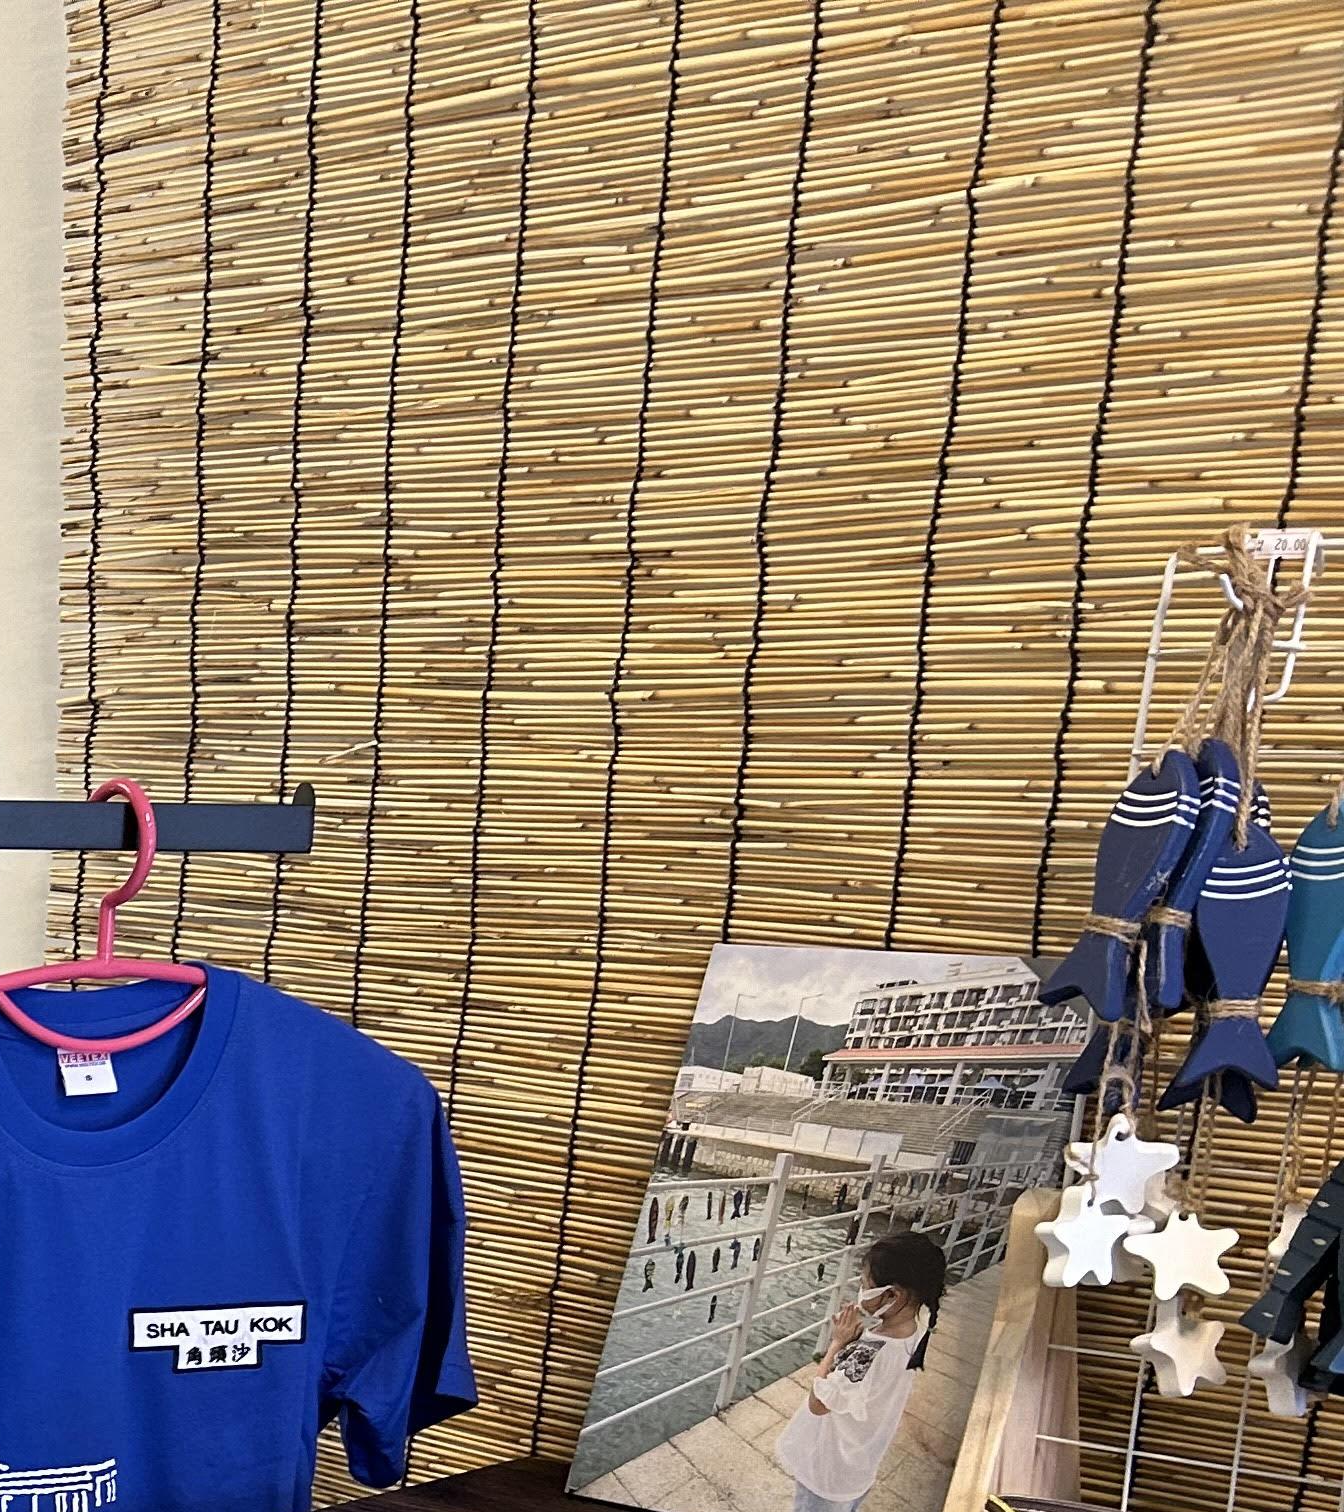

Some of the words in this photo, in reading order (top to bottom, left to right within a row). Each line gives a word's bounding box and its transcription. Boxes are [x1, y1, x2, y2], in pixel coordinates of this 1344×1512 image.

[146, 1323, 190, 1339] SHA
[200, 1319, 239, 1335] TAU
[250, 1317, 293, 1332] KOK
[186, 1343, 251, 1366] 角頭沙
